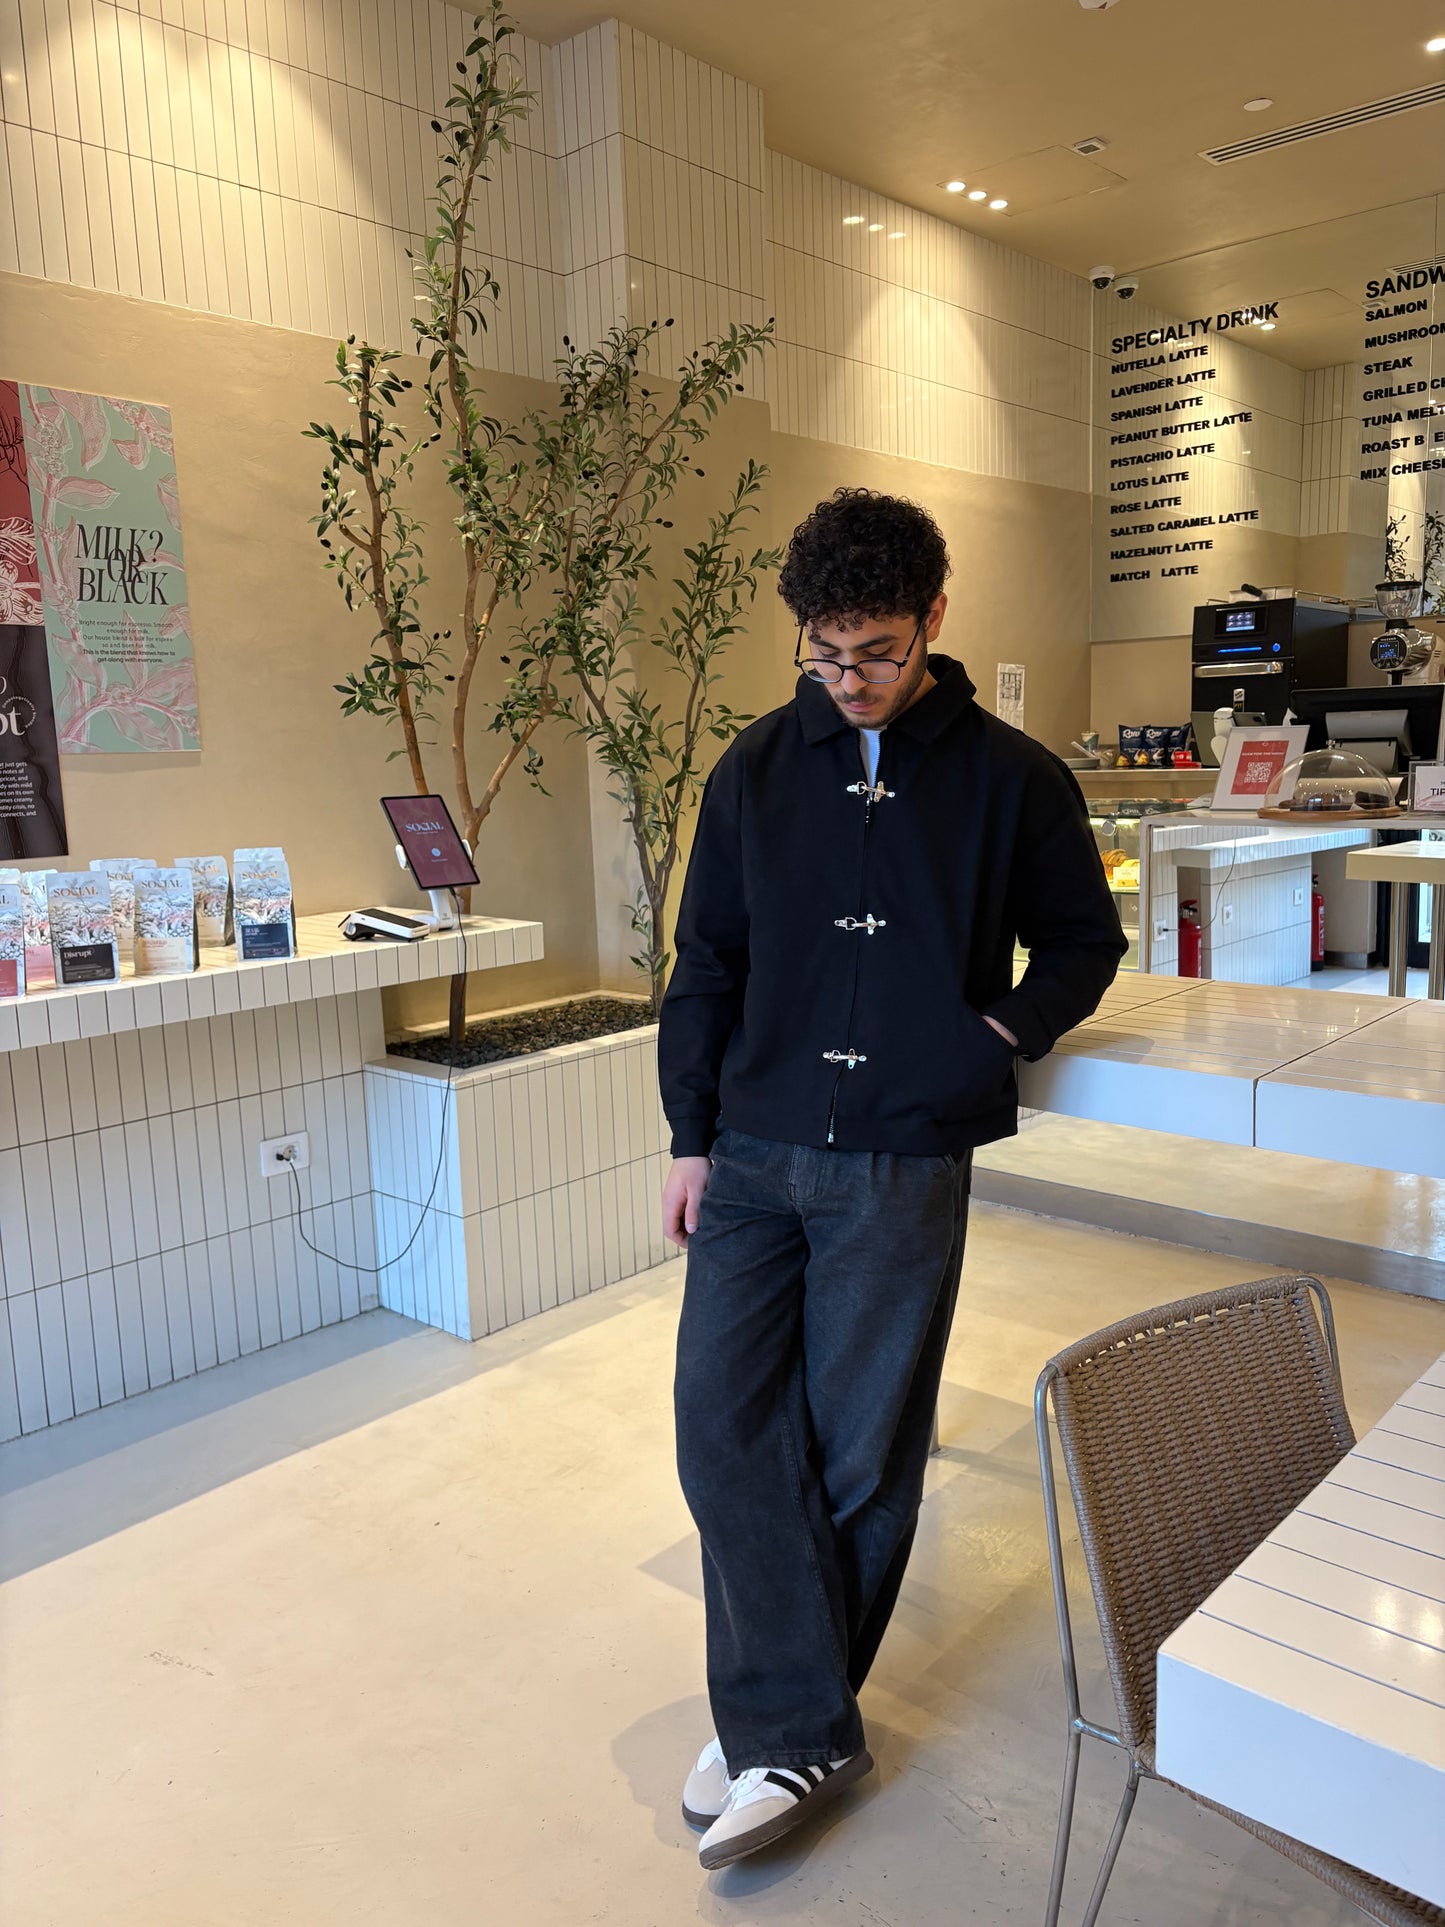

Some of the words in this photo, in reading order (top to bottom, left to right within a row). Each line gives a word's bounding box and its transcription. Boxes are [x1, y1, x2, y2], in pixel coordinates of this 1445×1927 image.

[1366, 299, 1427, 322] SALMON
[1111, 317, 1212, 354] SPECIALTY
[1217, 301, 1279, 331] DRINK
[1111, 355, 1166, 375] NUTELLA
[1169, 345, 1208, 362] LATTE
[1364, 356, 1413, 375] STEAK
[1111, 378, 1174, 398] LAVENDER
[1177, 369, 1216, 385] LATTE
[1363, 381, 1427, 401] GRILLED
[1110, 405, 1162, 422] SPANISH
[1165, 396, 1203, 412] LATTE
[1362, 412, 1403, 427] TUNA
[1111, 429, 1158, 445] PEANUT
[1161, 420, 1210, 436] BUTTER
[1214, 412, 1252, 427] LATTE
[1111, 450, 1173, 468] PISTACHIO
[1177, 443, 1215, 457] LATTE
[1362, 437, 1410, 454] ROAST
[1111, 478, 1148, 491] LOTUS
[1152, 471, 1189, 485] LATTE
[1361, 467, 1387, 480] MIX
[1111, 502, 1141, 514] ROSE
[1144, 497, 1181, 510] LATTE
[1110, 524, 1154, 537] SALTED
[1158, 516, 1215, 531] CARAMEL
[1219, 510, 1259, 523] LATTE
[74, 523, 163, 563] MILK?
[1110, 545, 1173, 560] HAZELNUT
[1175, 540, 1213, 552] LATTE
[107, 548, 145, 583] OR
[1110, 570, 1150, 582] MATCH
[1161, 565, 1199, 577] LATTE
[76, 567, 169, 606] BLACK
[53, 886, 99, 898] SOCIAL
[141, 879, 183, 889] SOCIAL
